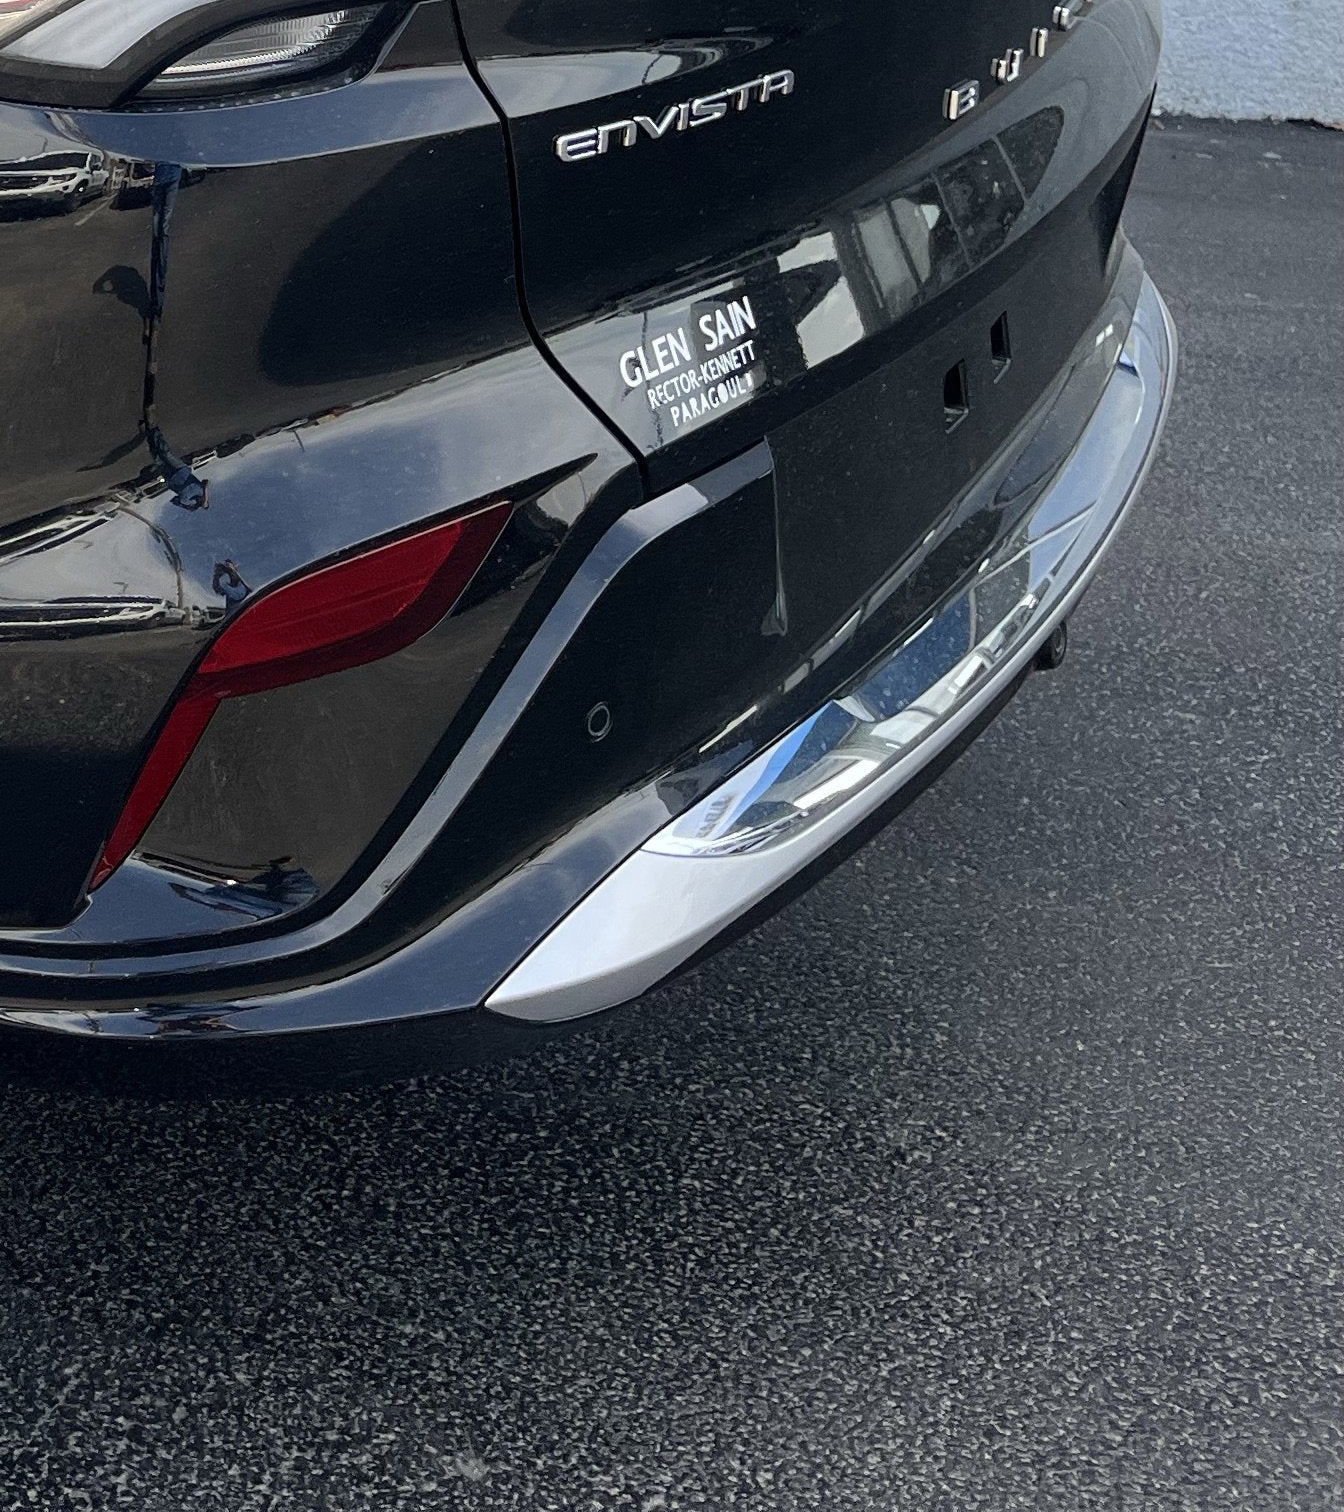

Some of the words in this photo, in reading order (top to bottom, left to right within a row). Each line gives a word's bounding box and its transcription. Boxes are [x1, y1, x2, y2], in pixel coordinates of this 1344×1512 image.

[553, 68, 795, 164] ENVISTA
[619, 327, 692, 388] GLEN
[699, 295, 757, 351] SAIN
[647, 339, 755, 409] RECTOR-KENNETT
